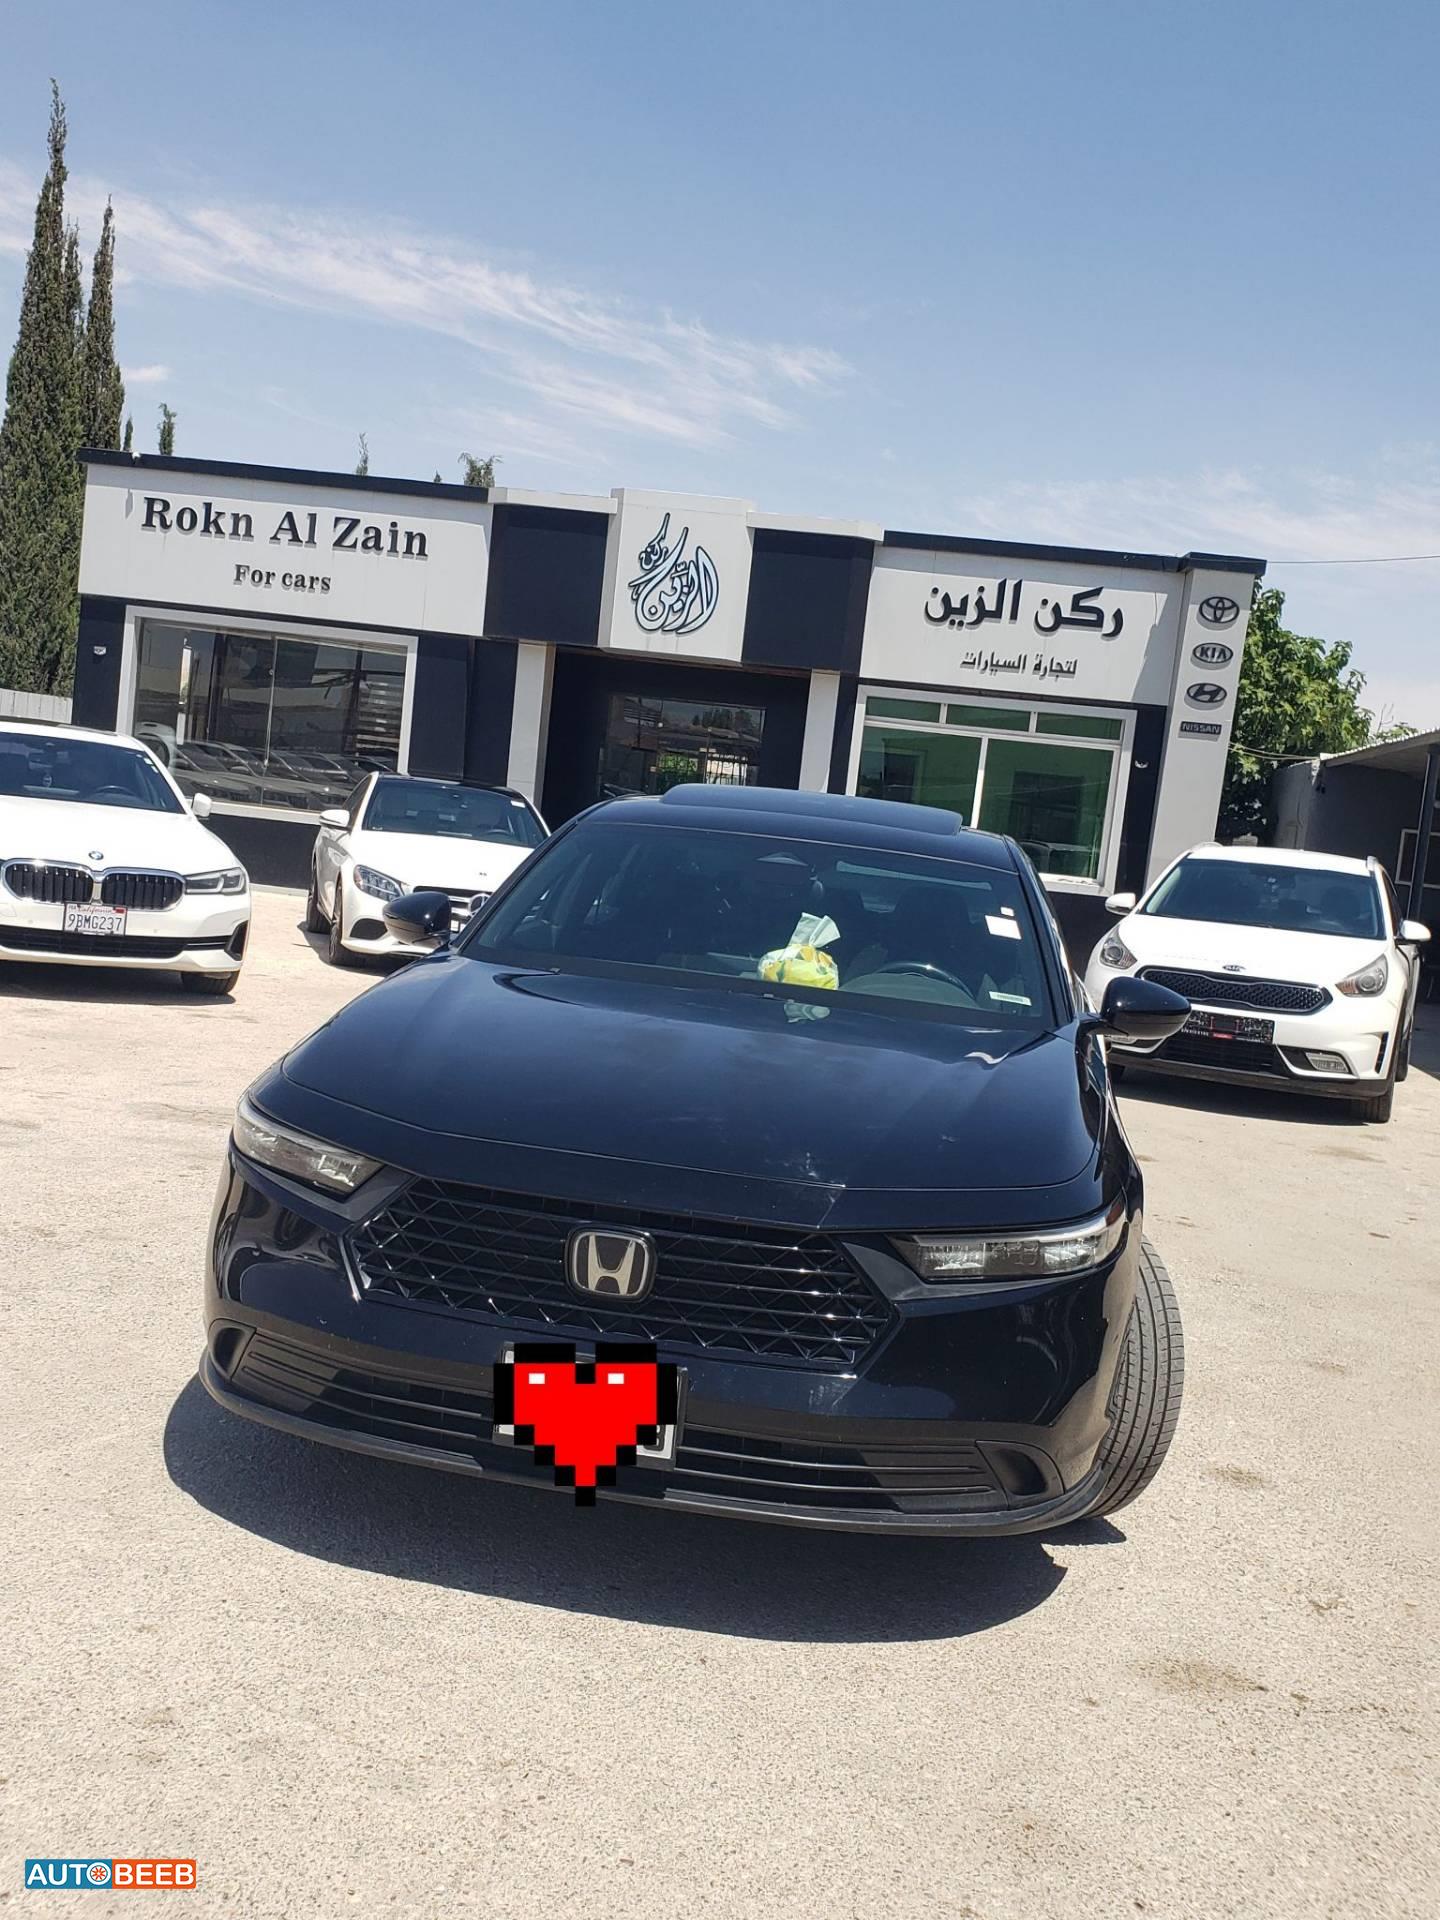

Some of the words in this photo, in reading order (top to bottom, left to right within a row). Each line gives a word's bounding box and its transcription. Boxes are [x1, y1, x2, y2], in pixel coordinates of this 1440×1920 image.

[141, 496, 254, 541] Rokn
[269, 511, 318, 548] Al
[332, 516, 429, 560] Zain
[233, 564, 276, 589] For
[281, 571, 332, 593] cars
[924, 577, 1024, 628] الزين
[1034, 586, 1124, 638] ركن
[960, 650, 1028, 676] السيارات
[1032, 653, 1079, 681] لتجارة
[1200, 647, 1227, 660] KIA
[1182, 723, 1220, 733] NISSAN
[68, 914, 122, 931] 9BMG237
